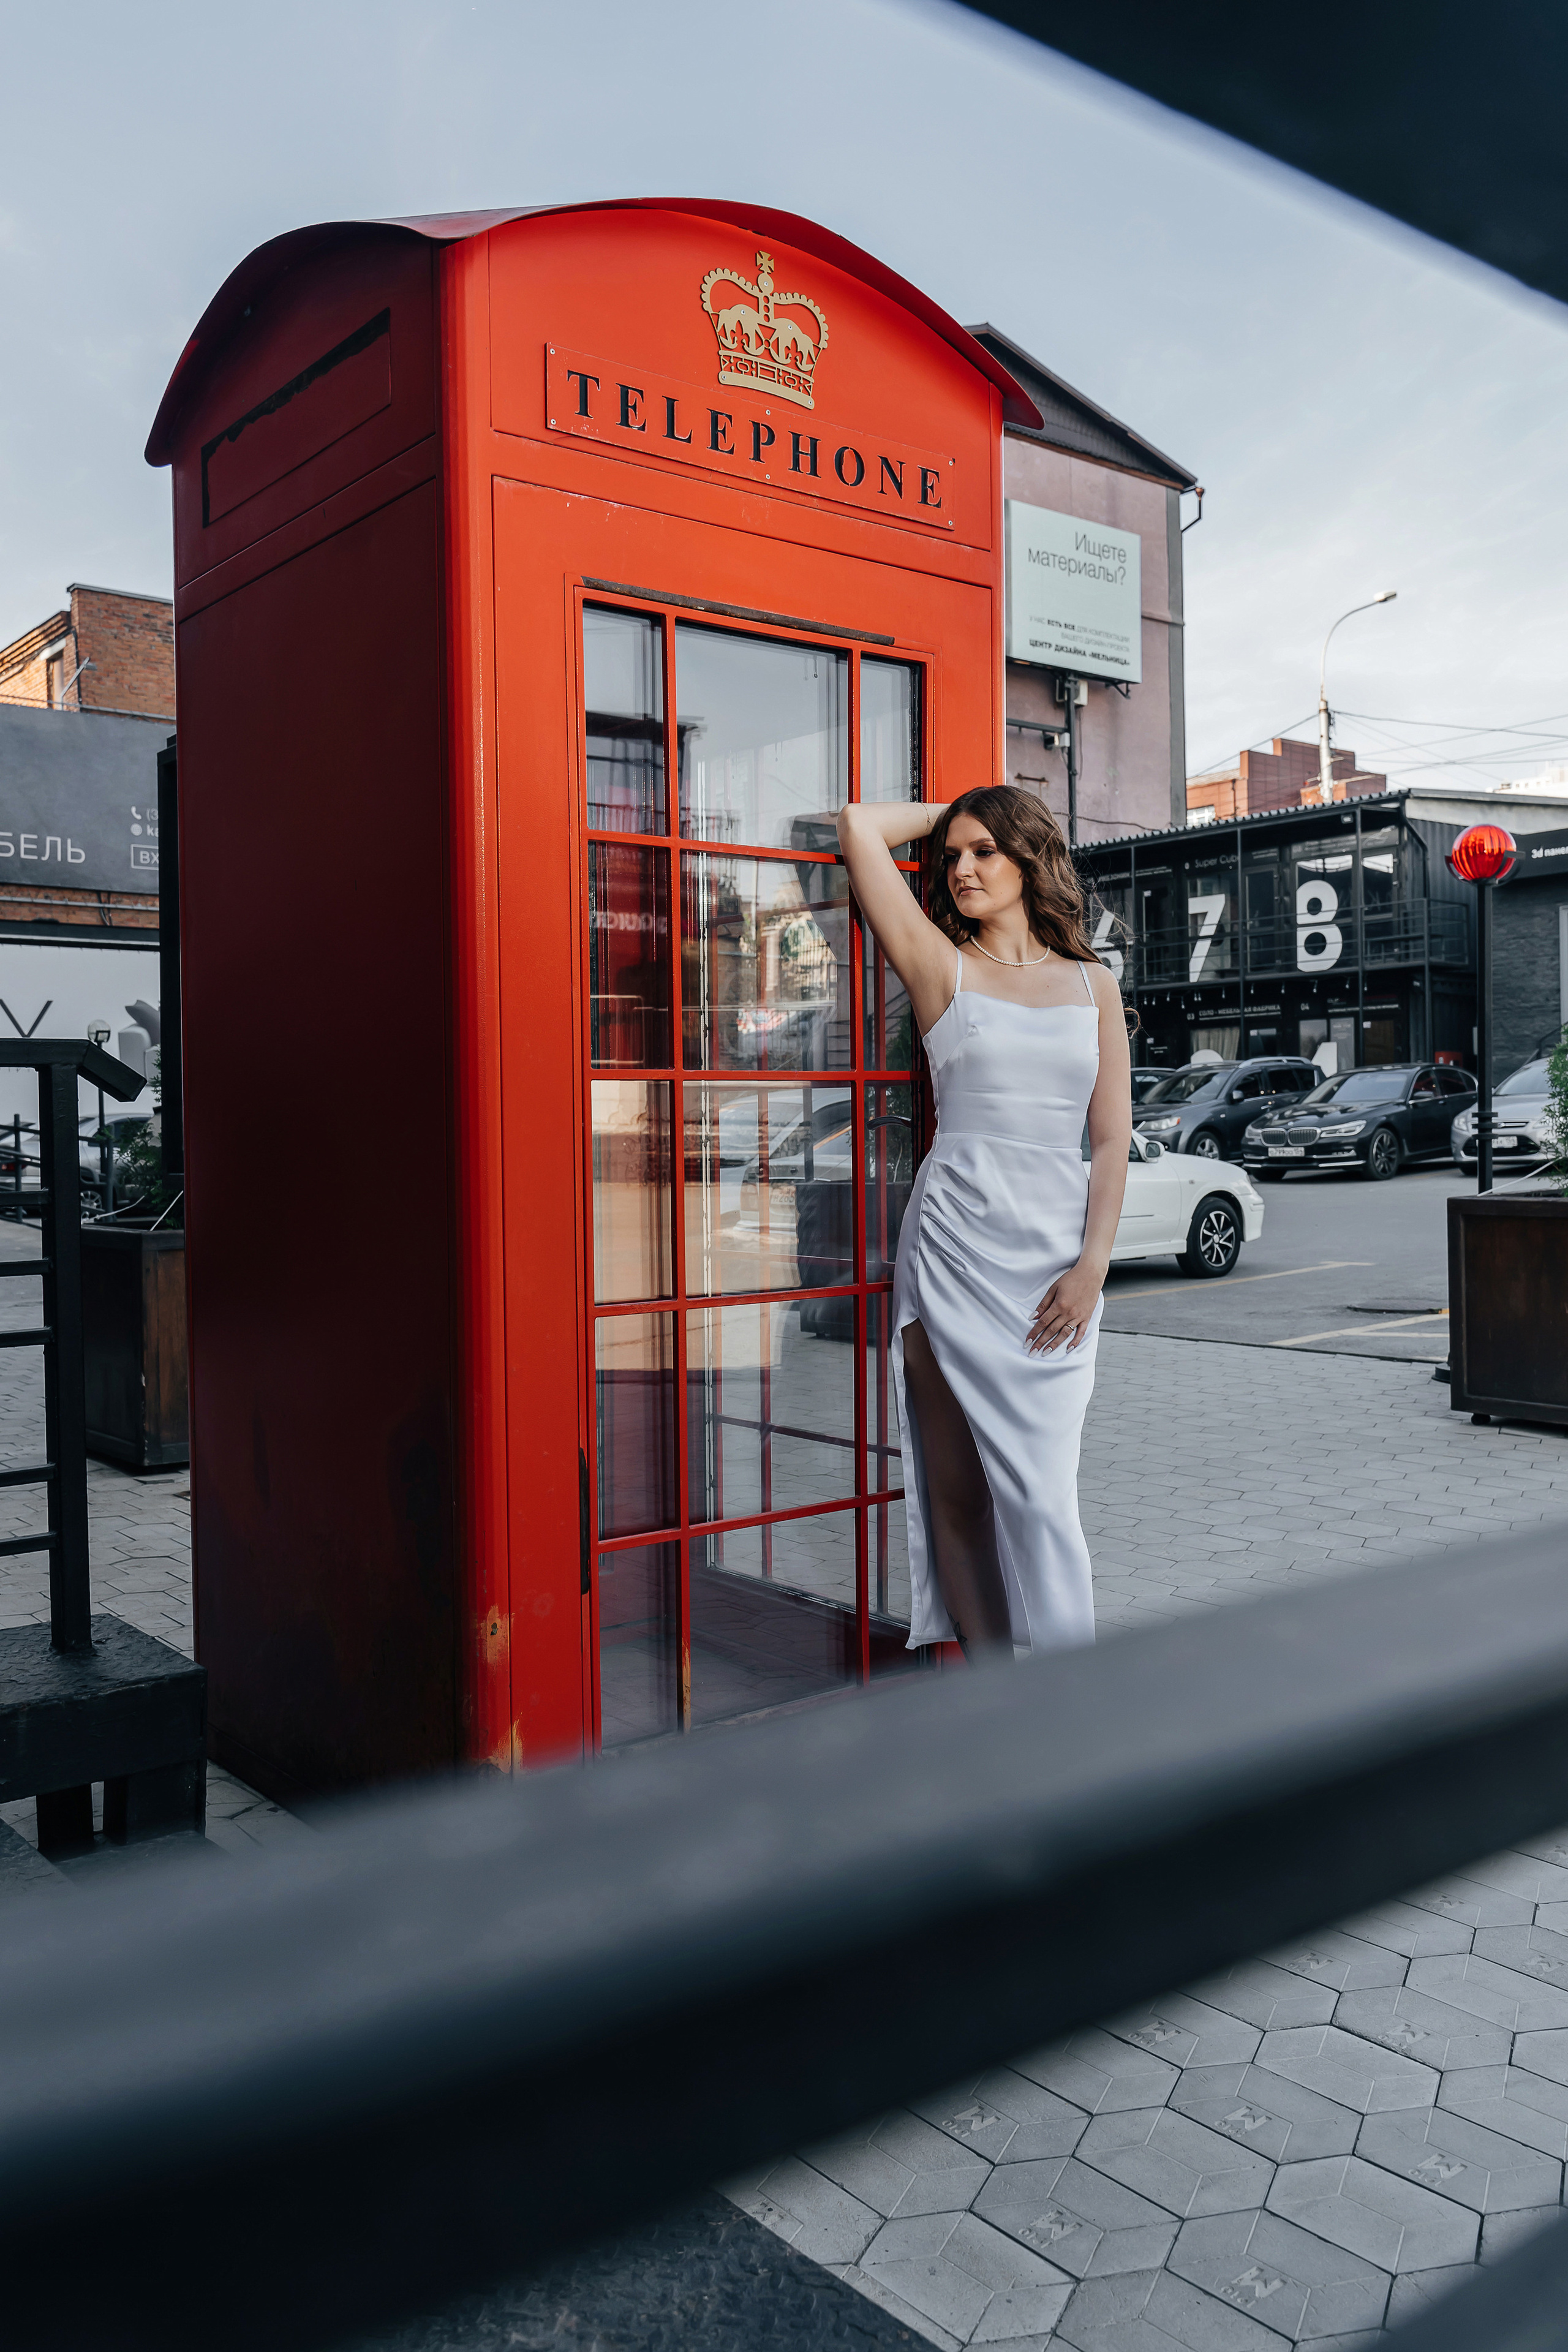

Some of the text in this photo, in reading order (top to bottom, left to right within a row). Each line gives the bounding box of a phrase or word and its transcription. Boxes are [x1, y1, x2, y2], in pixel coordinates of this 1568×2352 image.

[567, 369, 943, 509] TELEPHONE
[1028, 548, 1126, 586] материалы?
[1075, 532, 1127, 564] Ищете
[1029, 639, 1052, 649] ЦЕНТР
[1054, 644, 1087, 657] ДИЗАЙНА
[1189, 894, 1226, 982] 7
[1296, 880, 1343, 972] 8
